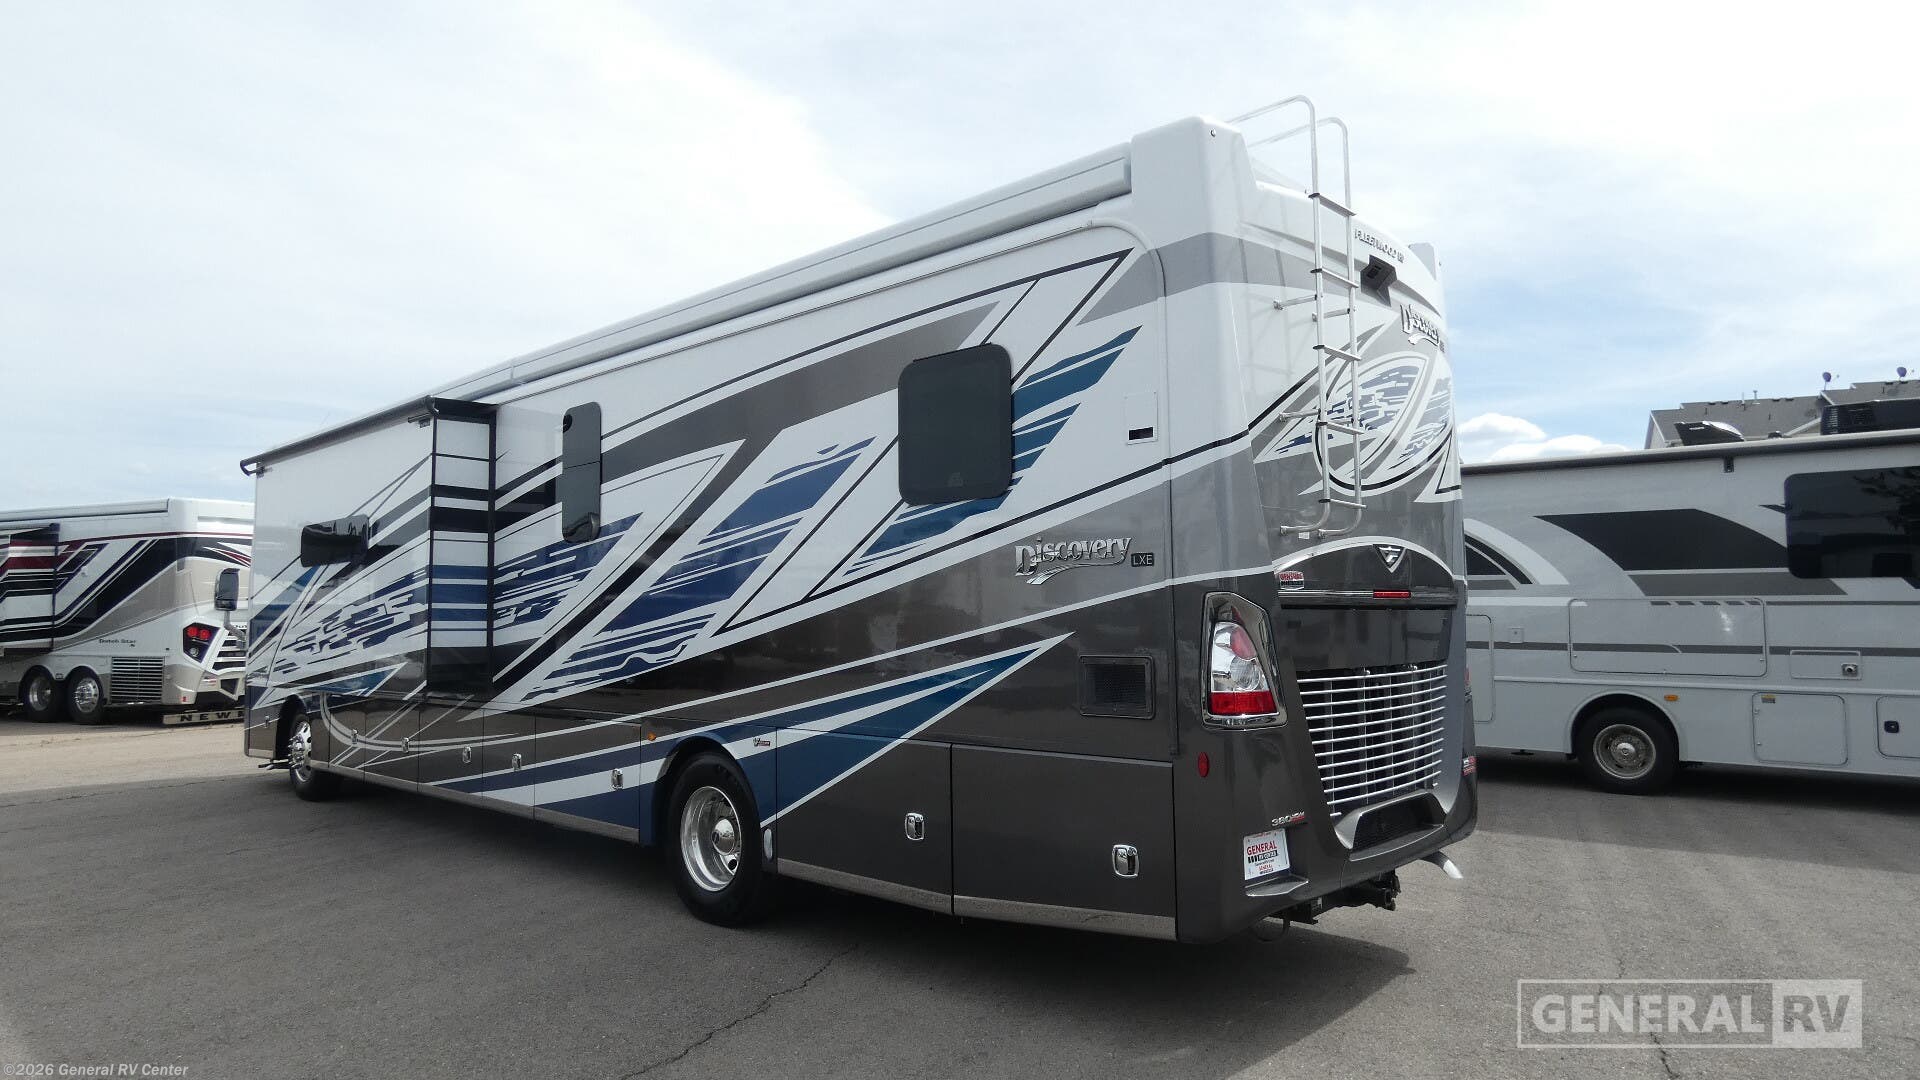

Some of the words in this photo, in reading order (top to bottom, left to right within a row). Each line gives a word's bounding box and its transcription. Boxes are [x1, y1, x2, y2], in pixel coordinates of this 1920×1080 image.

[1015, 536, 1132, 577] Discovery
[1132, 554, 1154, 567] LXE
[1247, 841, 1278, 856] GENERAL
